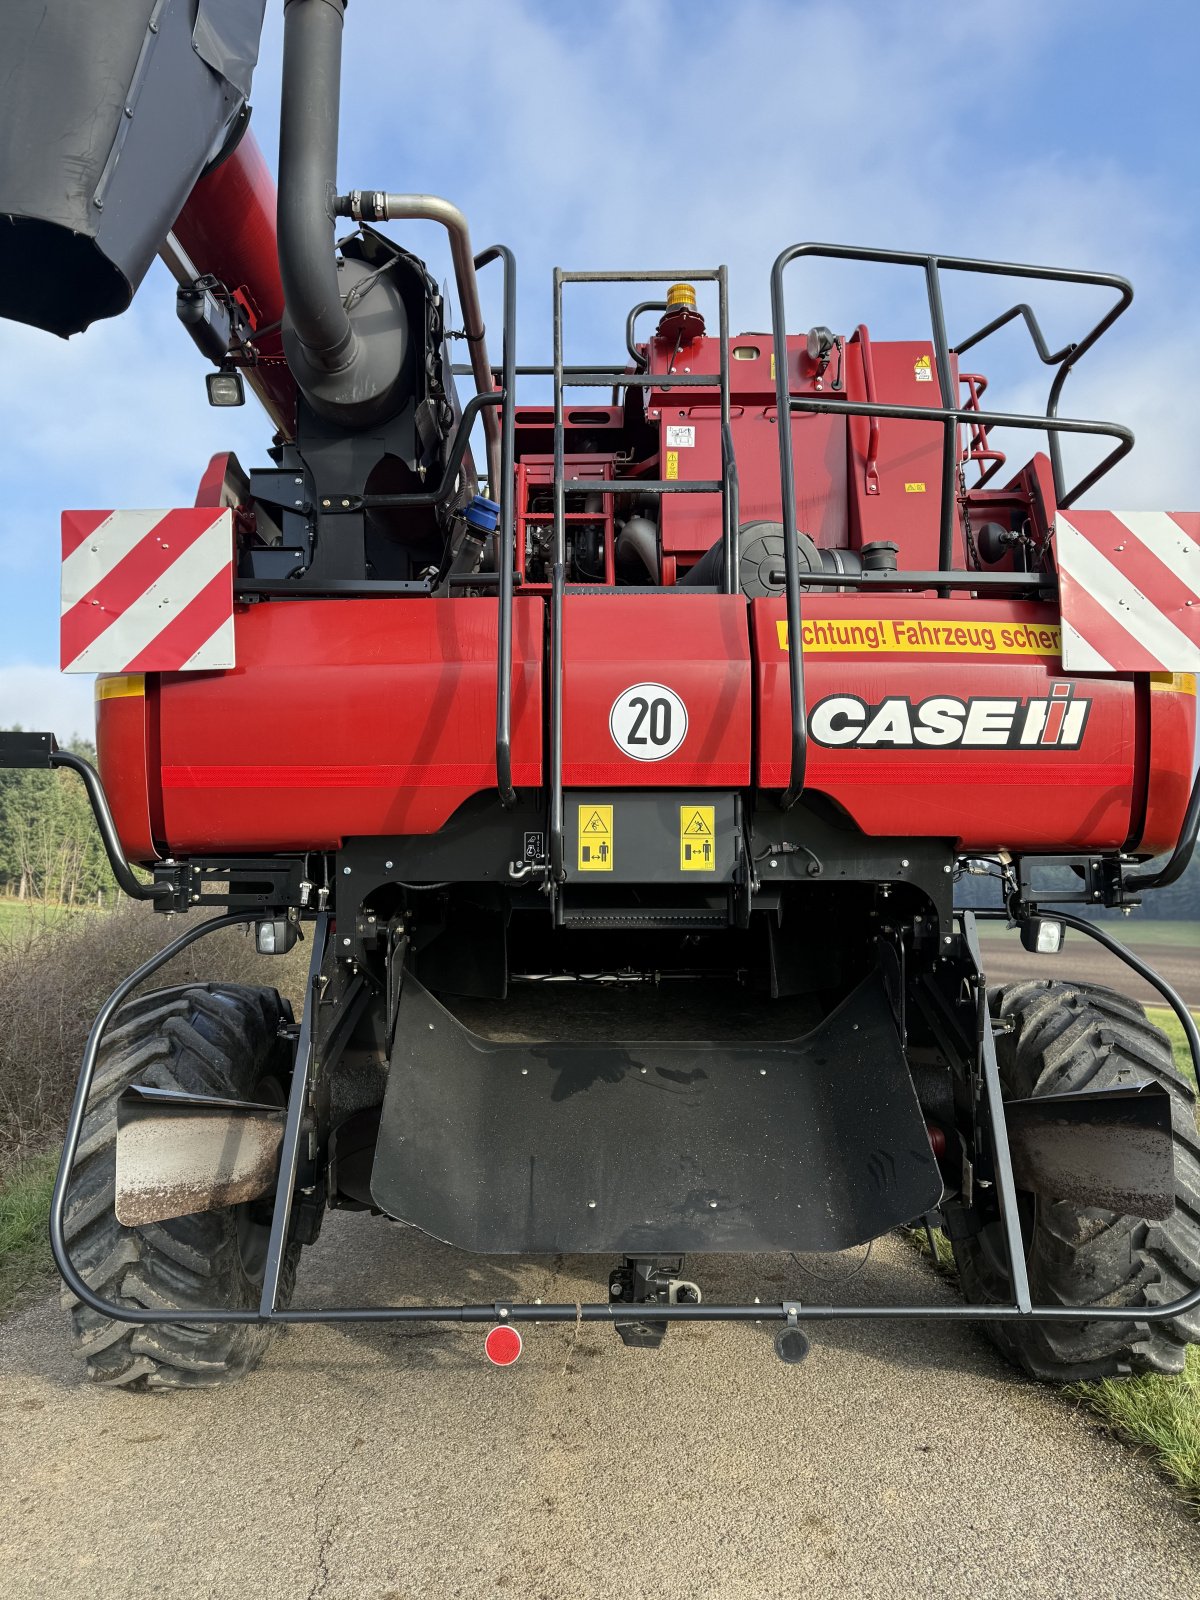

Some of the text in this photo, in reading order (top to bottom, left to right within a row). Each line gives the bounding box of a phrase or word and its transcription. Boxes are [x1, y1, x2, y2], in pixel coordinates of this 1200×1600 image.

[786, 621, 887, 648] chtung!
[892, 621, 997, 650] Fahrzeug
[1000, 624, 1062, 649] scher
[627, 697, 672, 746] 20
[811, 697, 1018, 745] CASE
